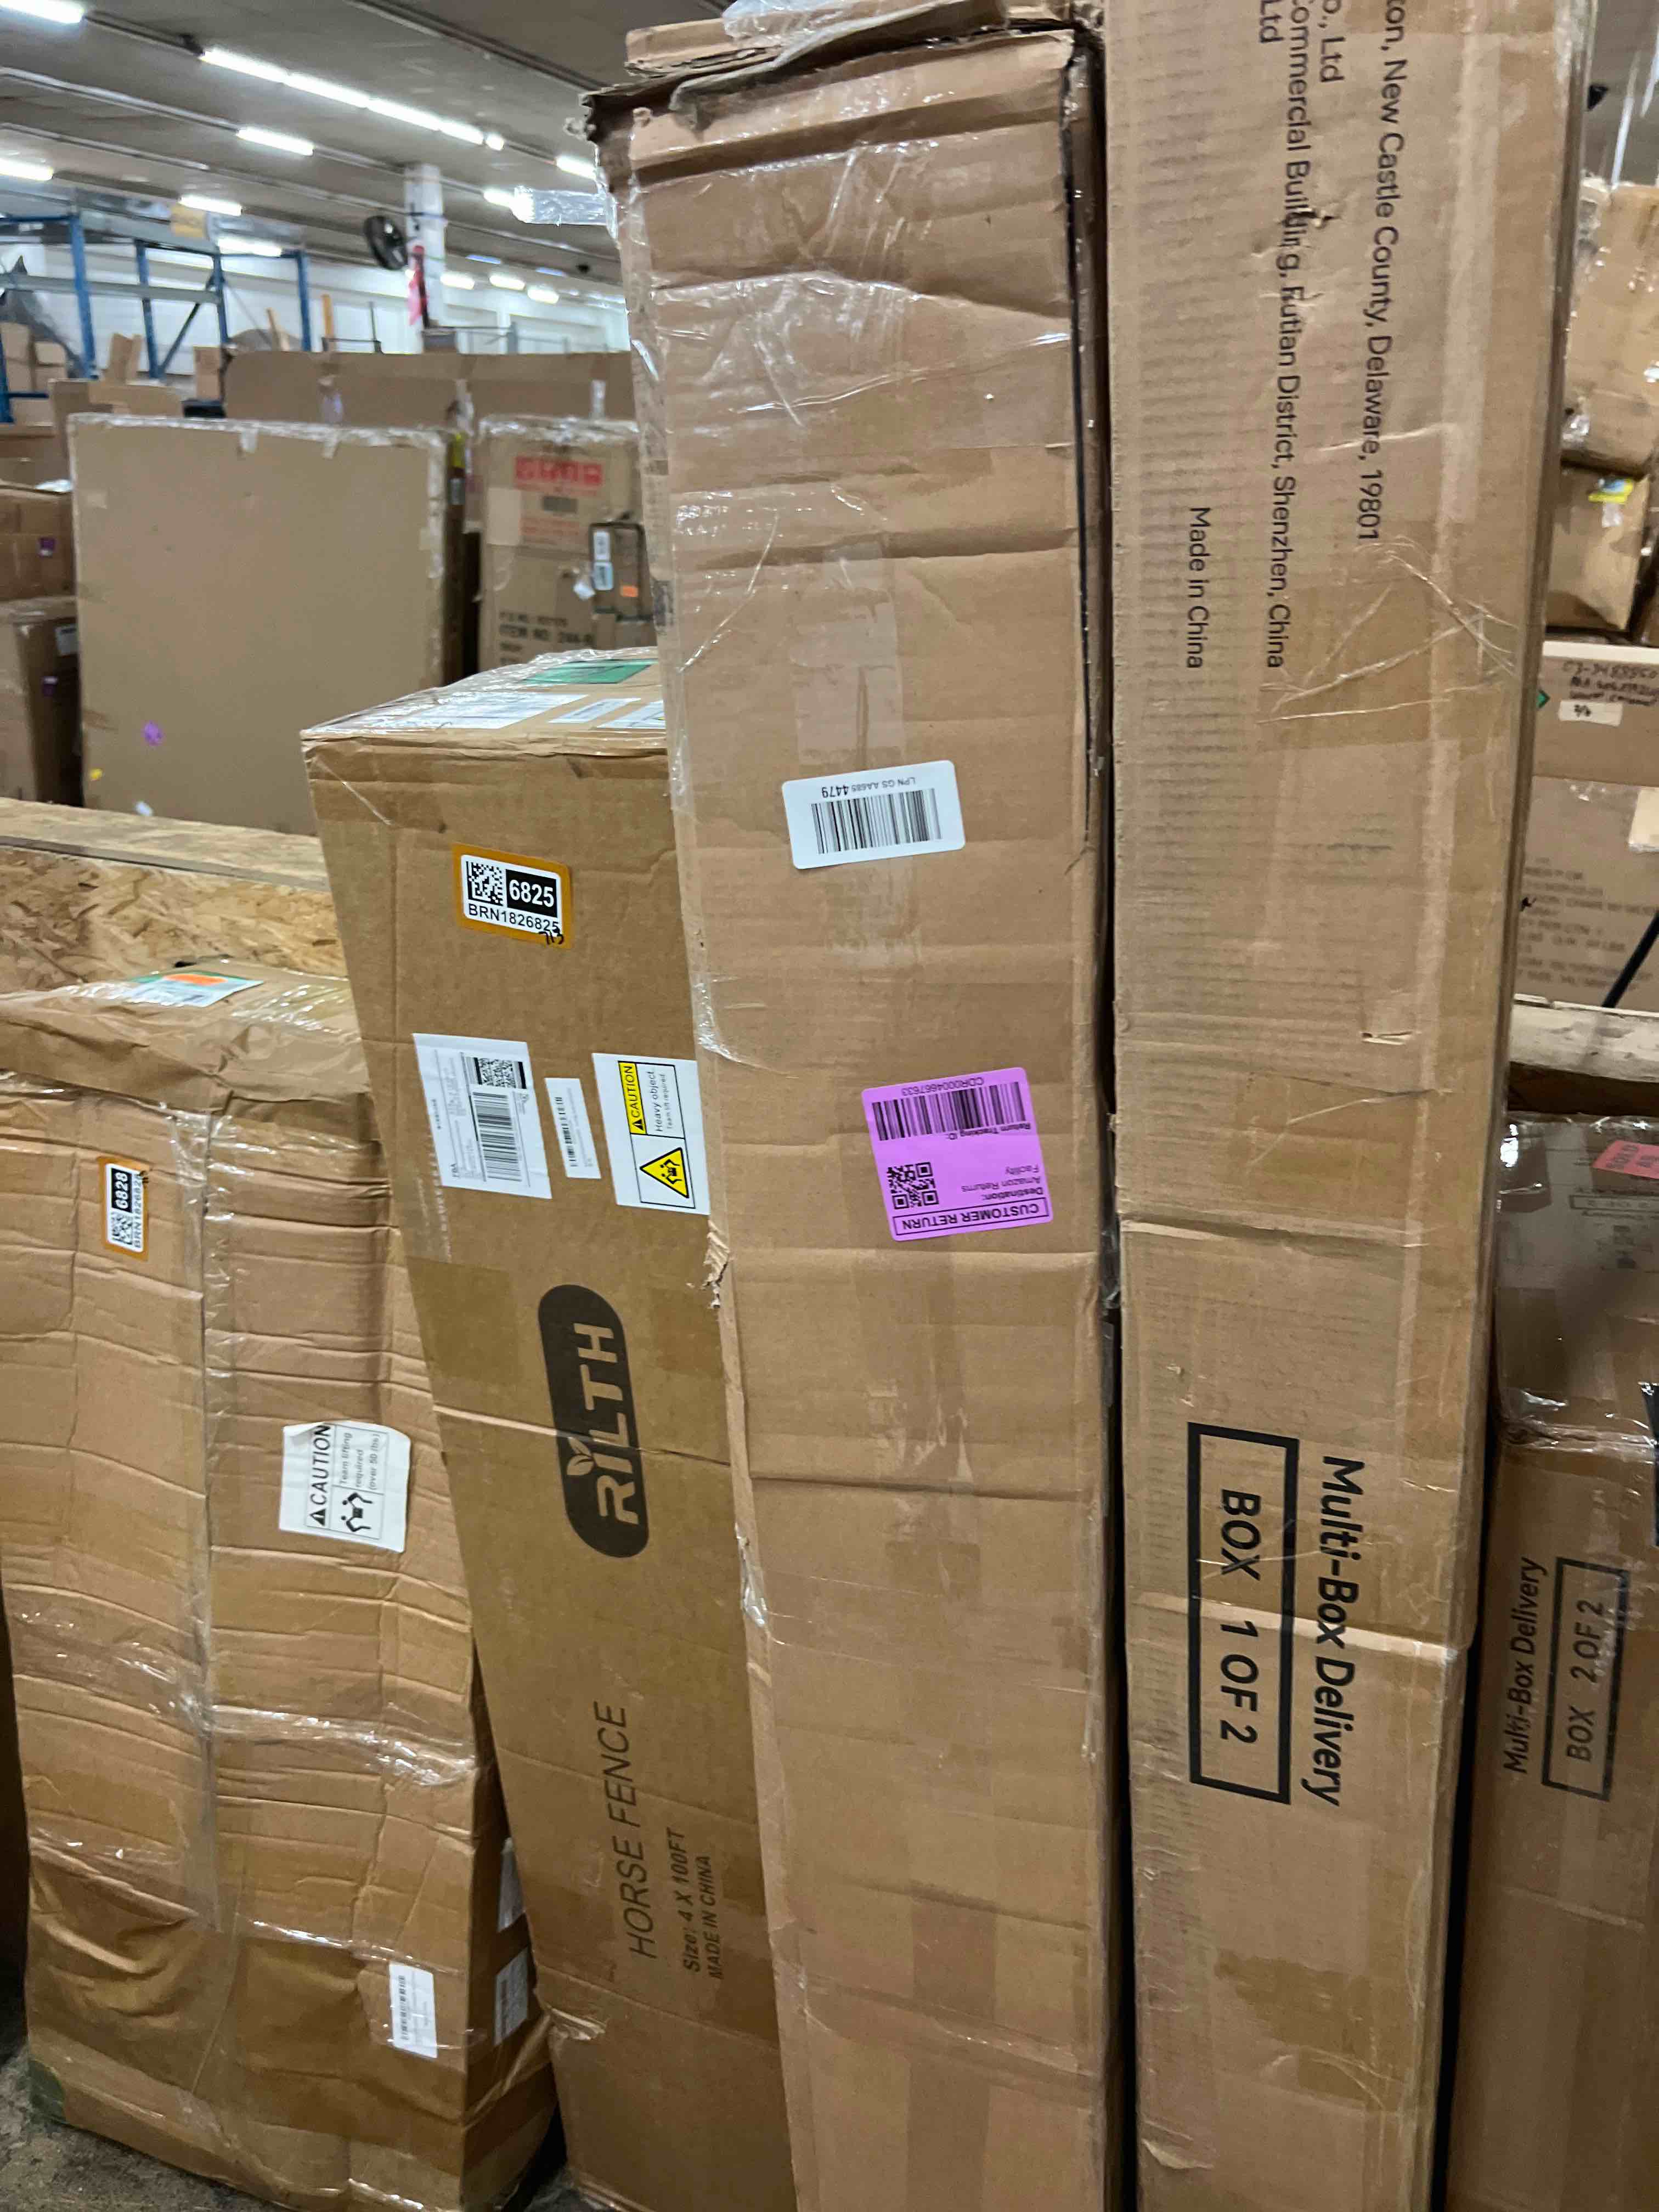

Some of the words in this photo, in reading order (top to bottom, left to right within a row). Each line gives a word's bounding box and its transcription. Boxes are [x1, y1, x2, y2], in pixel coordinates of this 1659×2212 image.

[1259, 0, 1284, 43] Ltd
[1320, 36, 1345, 82] Ltd
[1381, 59, 1408, 124] New
[1375, 132, 1405, 218] Castle
[1363, 226, 1399, 327] County,
[1271, 376, 1300, 469] District,
[1358, 335, 1392, 461] Delaware,
[1358, 470, 1384, 540] 19801
[1189, 507, 1211, 571] Made
[1267, 476, 1297, 597] Shenzhen,
[1188, 580, 1210, 599] in
[1186, 606, 1210, 669] China
[1267, 604, 1291, 668] China
[821, 785, 849, 799] 4479
[469, 903, 560, 932] BRN1826825
[509, 879, 555, 908] 6825
[623, 1065, 641, 1118] CAUTION
[646, 1071, 659, 1100] object
[654, 1103, 663, 1132] Heavy
[114, 1172, 129, 1210] 6828
[961, 1203, 1040, 1223] CUSTOMER
[902, 1213, 957, 1230] RETURN
[573, 1322, 639, 1525] RILTH
[310, 1425, 332, 1505] CAUTION
[356, 1449, 365, 1487] required
[1220, 1488, 1261, 1582] BOX
[1315, 1455, 1365, 1650] Multi-Box
[1220, 1620, 1259, 1638] 1
[1510, 1556, 1549, 1656] Delivery
[1576, 1599, 1604, 1617] 2
[1573, 1622, 1601, 1660] OF
[1220, 1653, 1259, 1712] OF
[1570, 1665, 1598, 1684] 2
[1219, 1719, 1259, 1745] 2
[1300, 1655, 1356, 1808] Delivery
[1503, 1660, 1534, 1775] Multi-Box
[1565, 1706, 1595, 1763] BOX
[593, 1701, 641, 1828] FENCE
[667, 1827, 690, 1883] 100FT
[695, 1856, 715, 1907] CHINA
[612, 1835, 658, 1960] HORSE
[678, 1910, 694, 1922] 4
[701, 1910, 718, 1929] IN
[703, 1930, 723, 1980] MADE
